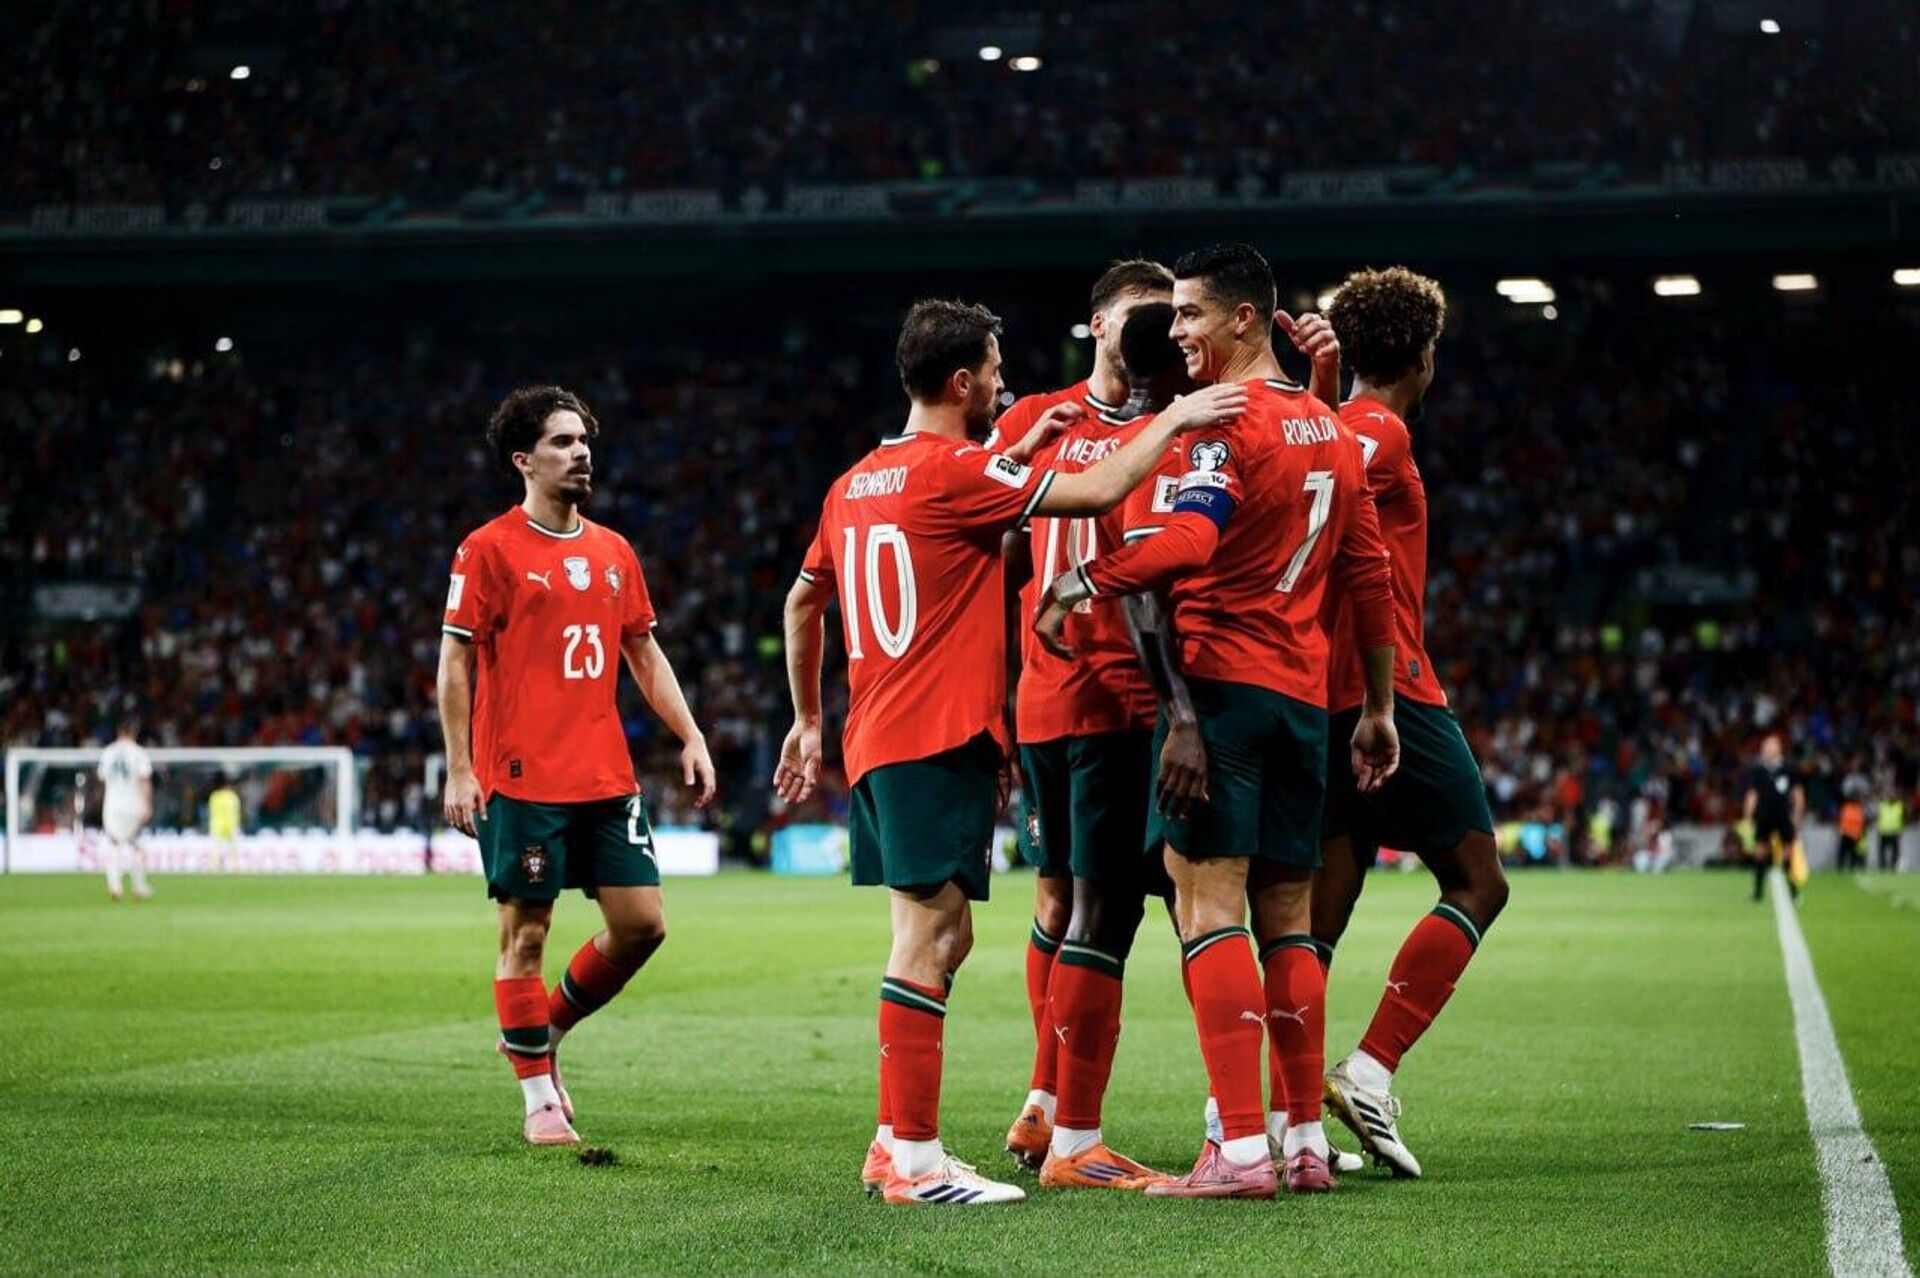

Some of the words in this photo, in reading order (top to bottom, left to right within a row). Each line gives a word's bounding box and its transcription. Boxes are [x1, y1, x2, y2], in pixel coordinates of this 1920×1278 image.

[1274, 470, 1334, 594] 7
[843, 523, 918, 660] 10
[562, 624, 605, 680] 23
[625, 797, 652, 845] 2
